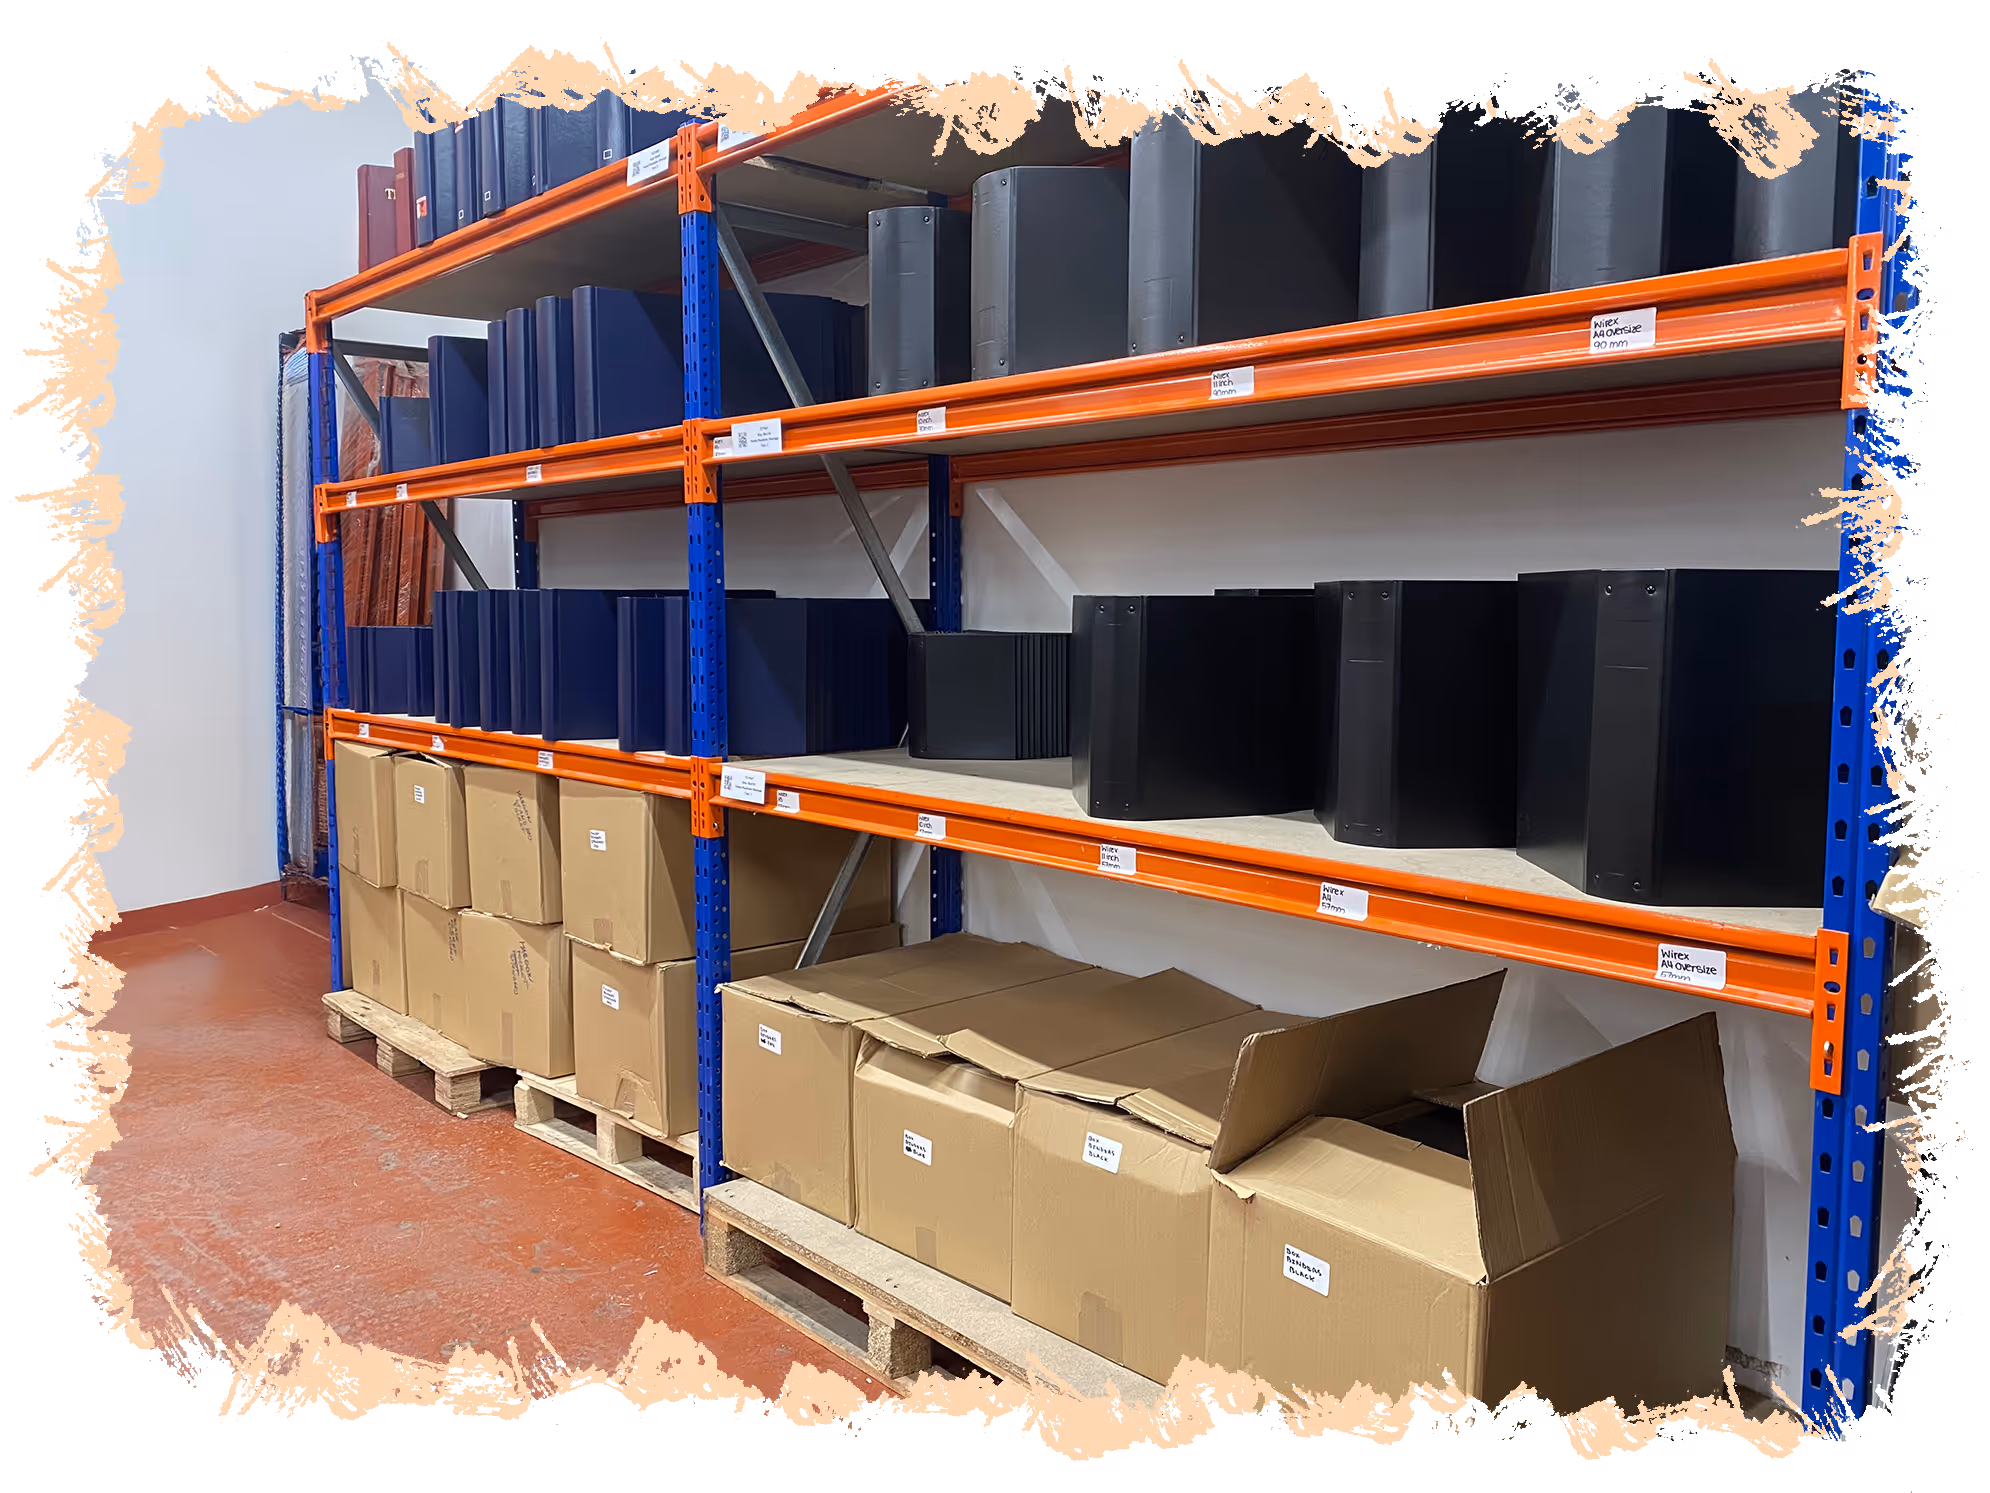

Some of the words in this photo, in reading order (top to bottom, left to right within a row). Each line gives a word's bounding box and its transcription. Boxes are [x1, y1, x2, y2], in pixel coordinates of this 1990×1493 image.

[1323, 884, 1344, 896] Wirex
[1322, 892, 1332, 902] A4
[1321, 902, 1345, 913] 57mm
[1660, 948, 1690, 961] Wirex
[1661, 959, 1674, 969] A4
[1660, 970, 1691, 981] 57mm
[1286, 1247, 1300, 1258] BOX
[1286, 1255, 1322, 1277] BINDERS
[1289, 1265, 1315, 1282] BLACK
